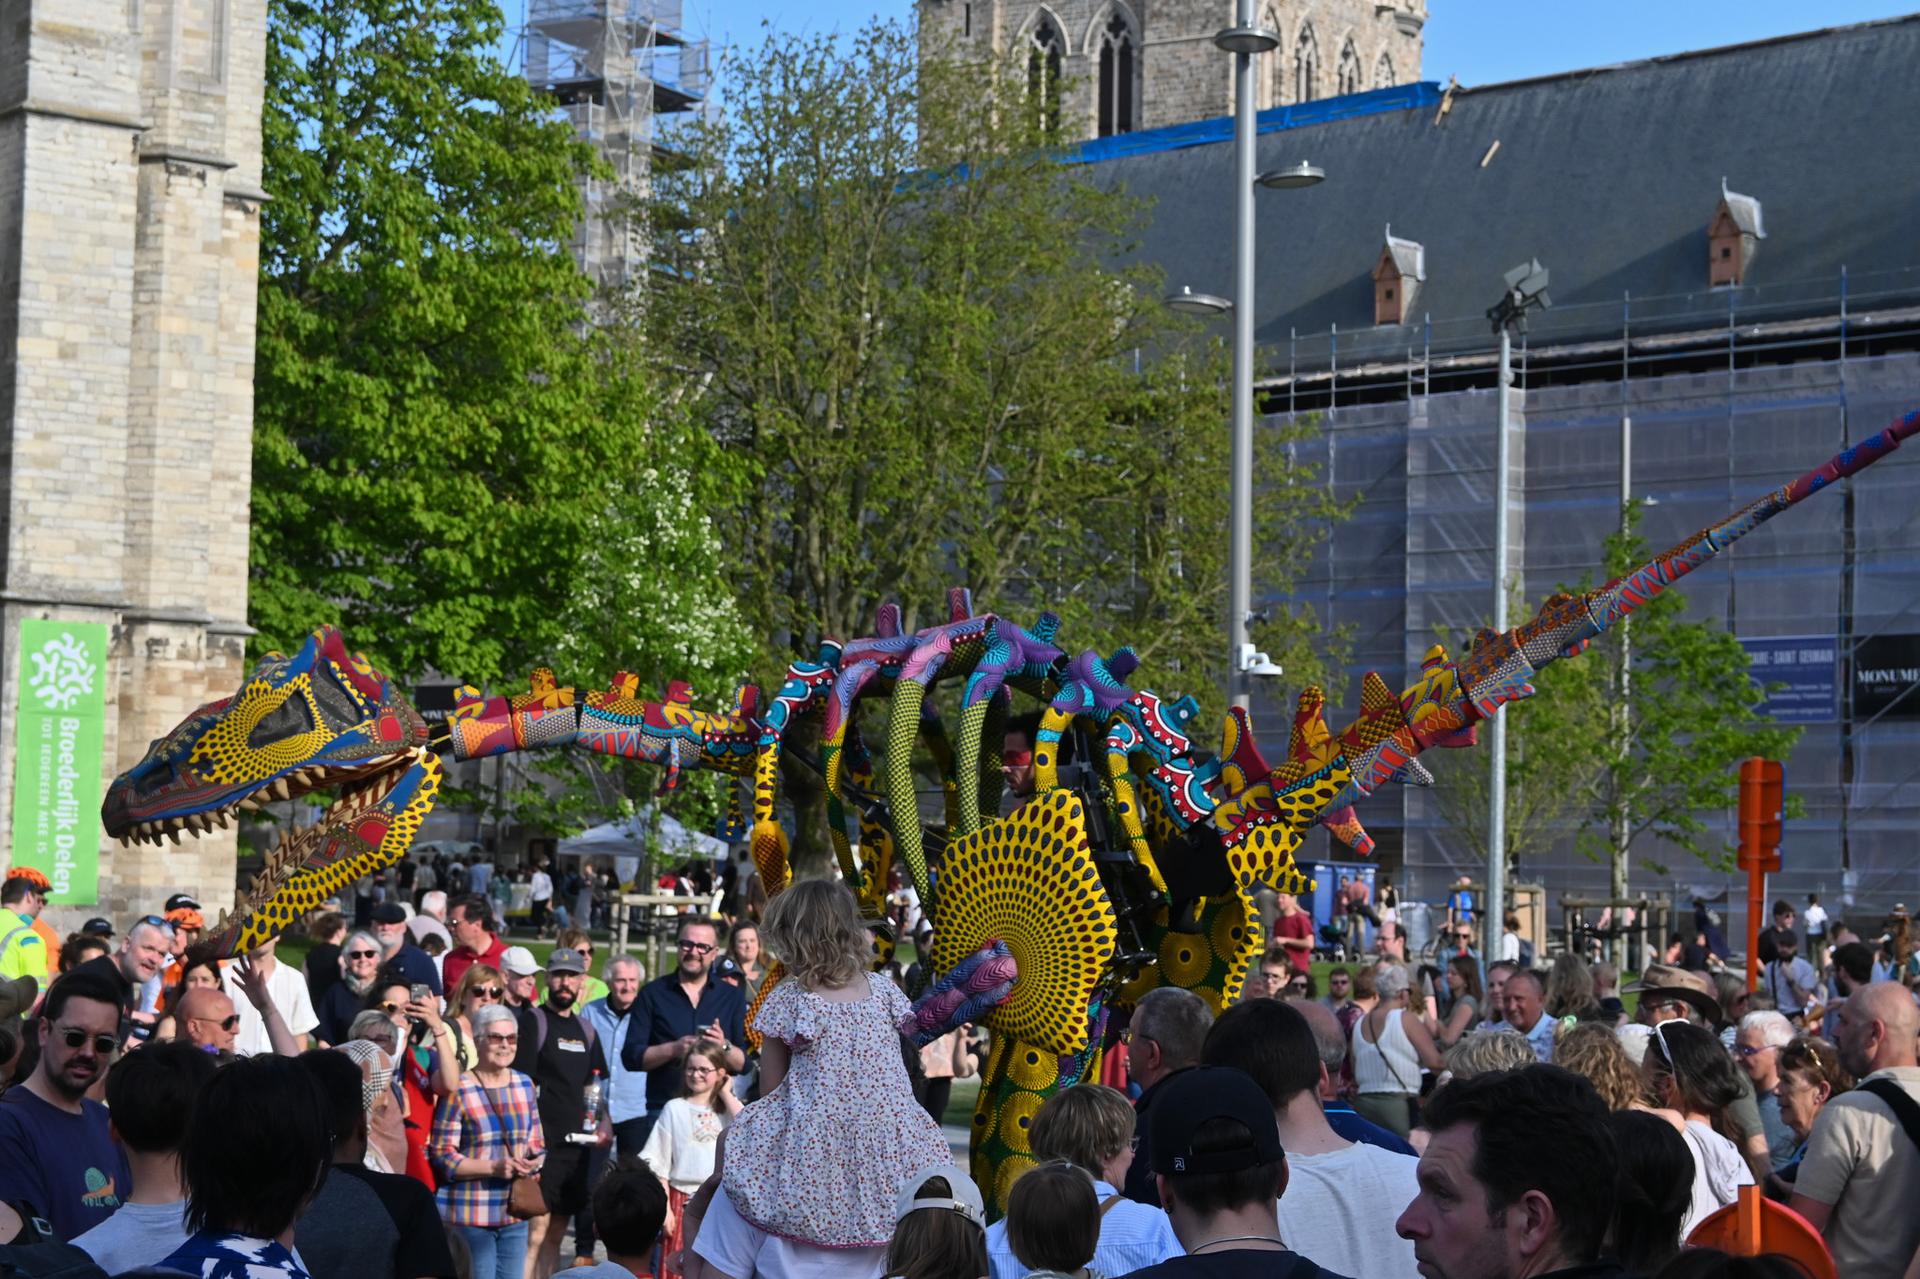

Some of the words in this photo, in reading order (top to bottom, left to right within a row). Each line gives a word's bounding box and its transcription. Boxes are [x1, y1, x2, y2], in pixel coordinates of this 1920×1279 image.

[41, 717, 53, 739] TOT
[38, 744, 52, 805] IEDEREEN
[52, 717, 80, 832] Broederlijk
[37, 809, 49, 838] MEE
[36, 841, 48, 854] IS
[53, 834, 77, 895] Delen
